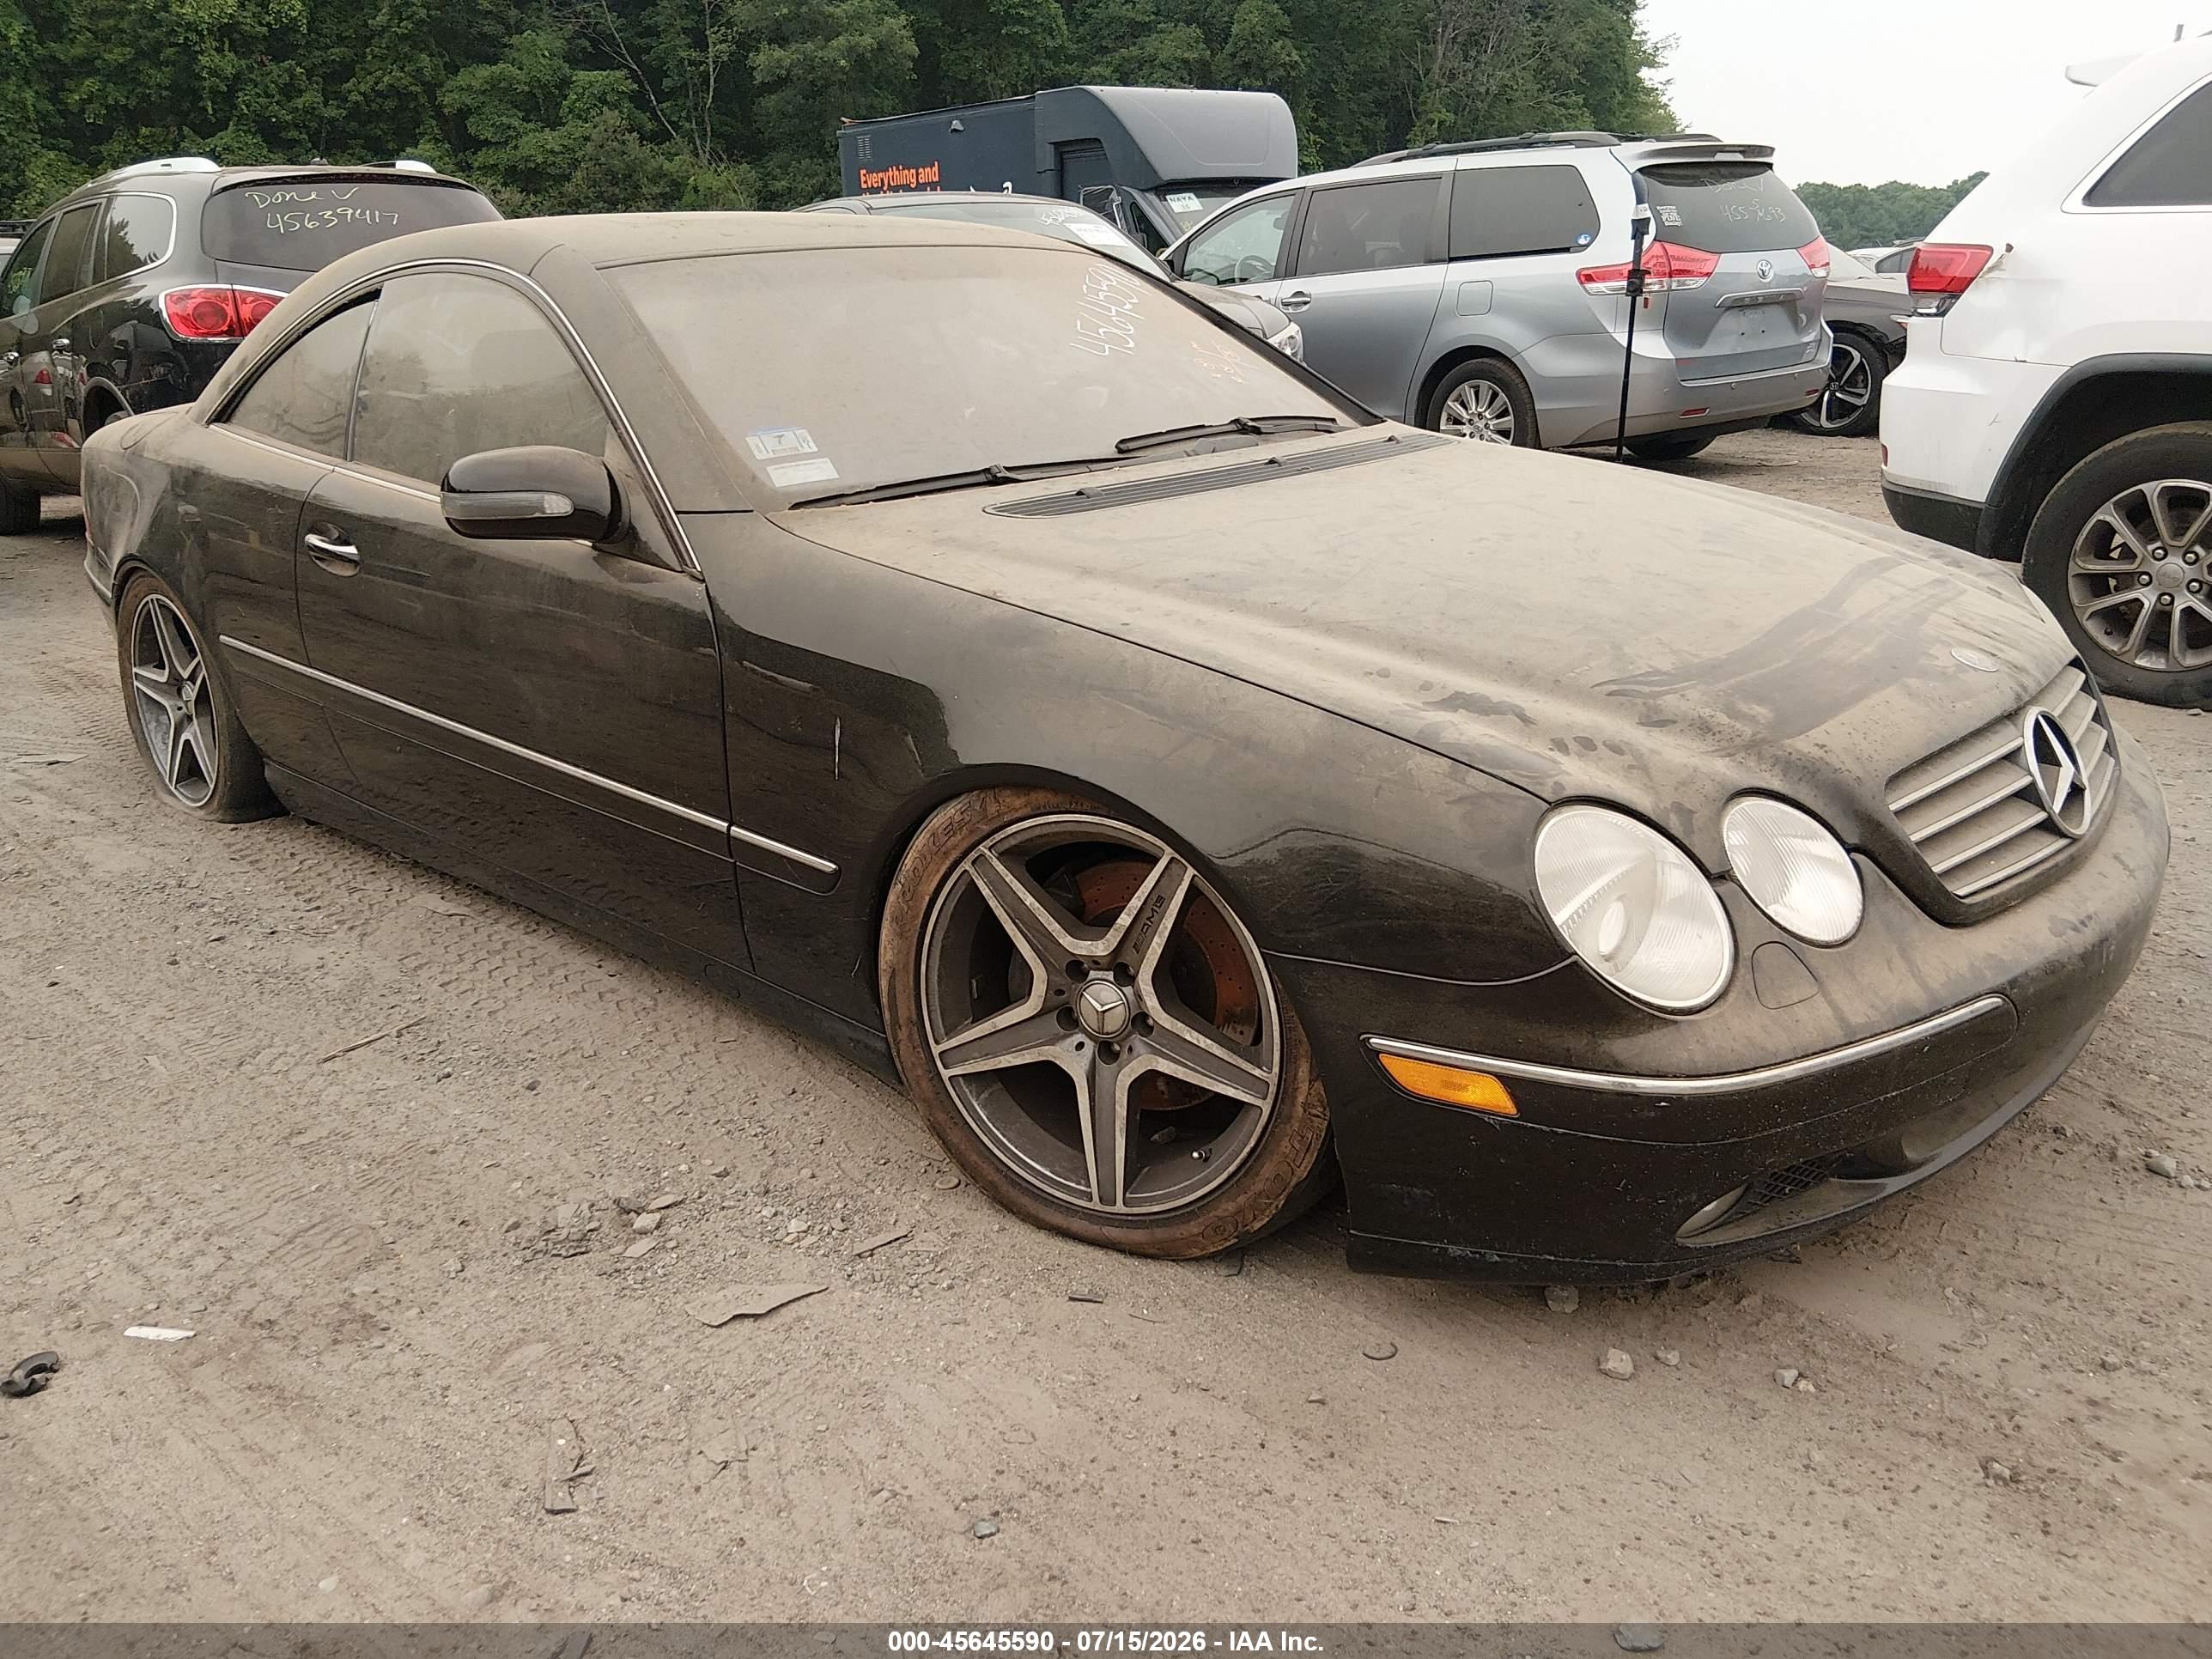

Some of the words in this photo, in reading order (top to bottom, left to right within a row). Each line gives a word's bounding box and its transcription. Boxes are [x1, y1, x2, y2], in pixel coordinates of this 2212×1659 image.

[860, 163, 916, 190] Everything
[918, 161, 939, 184] and
[245, 191, 324, 209] Done
[266, 207, 399, 234] 45639417
[1201, 1126, 1314, 1243] TOYO
